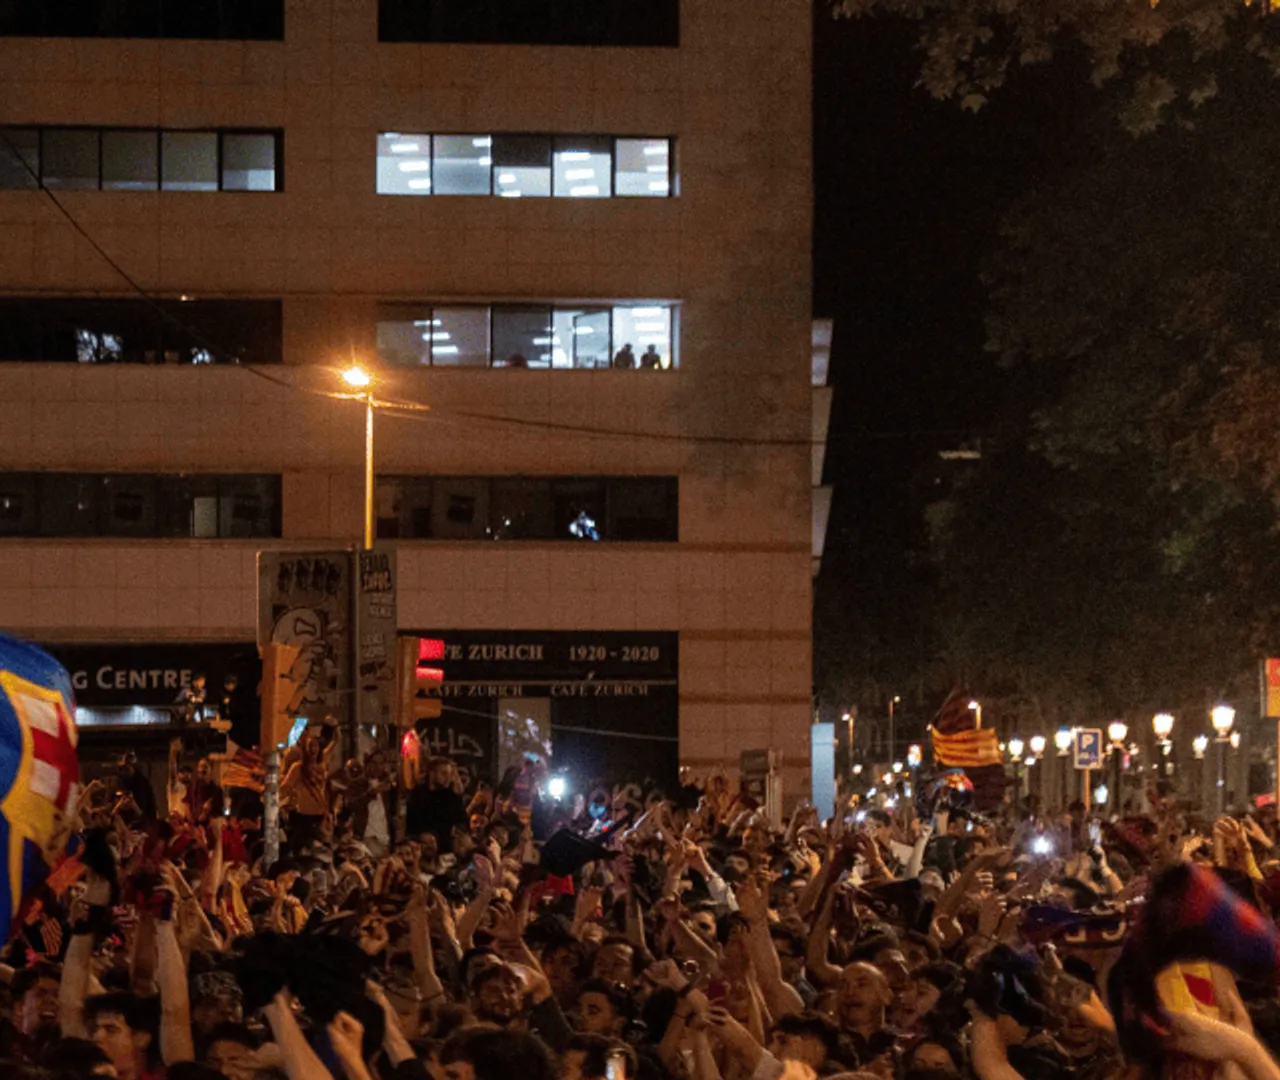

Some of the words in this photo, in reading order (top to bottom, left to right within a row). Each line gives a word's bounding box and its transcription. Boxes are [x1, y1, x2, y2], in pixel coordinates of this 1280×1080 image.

[468, 644, 543, 661] ZURICH
[570, 646, 606, 662] 1920
[623, 646, 659, 662] 2020
[96, 665, 192, 689] CENTRE
[1081, 734, 1094, 749] P
